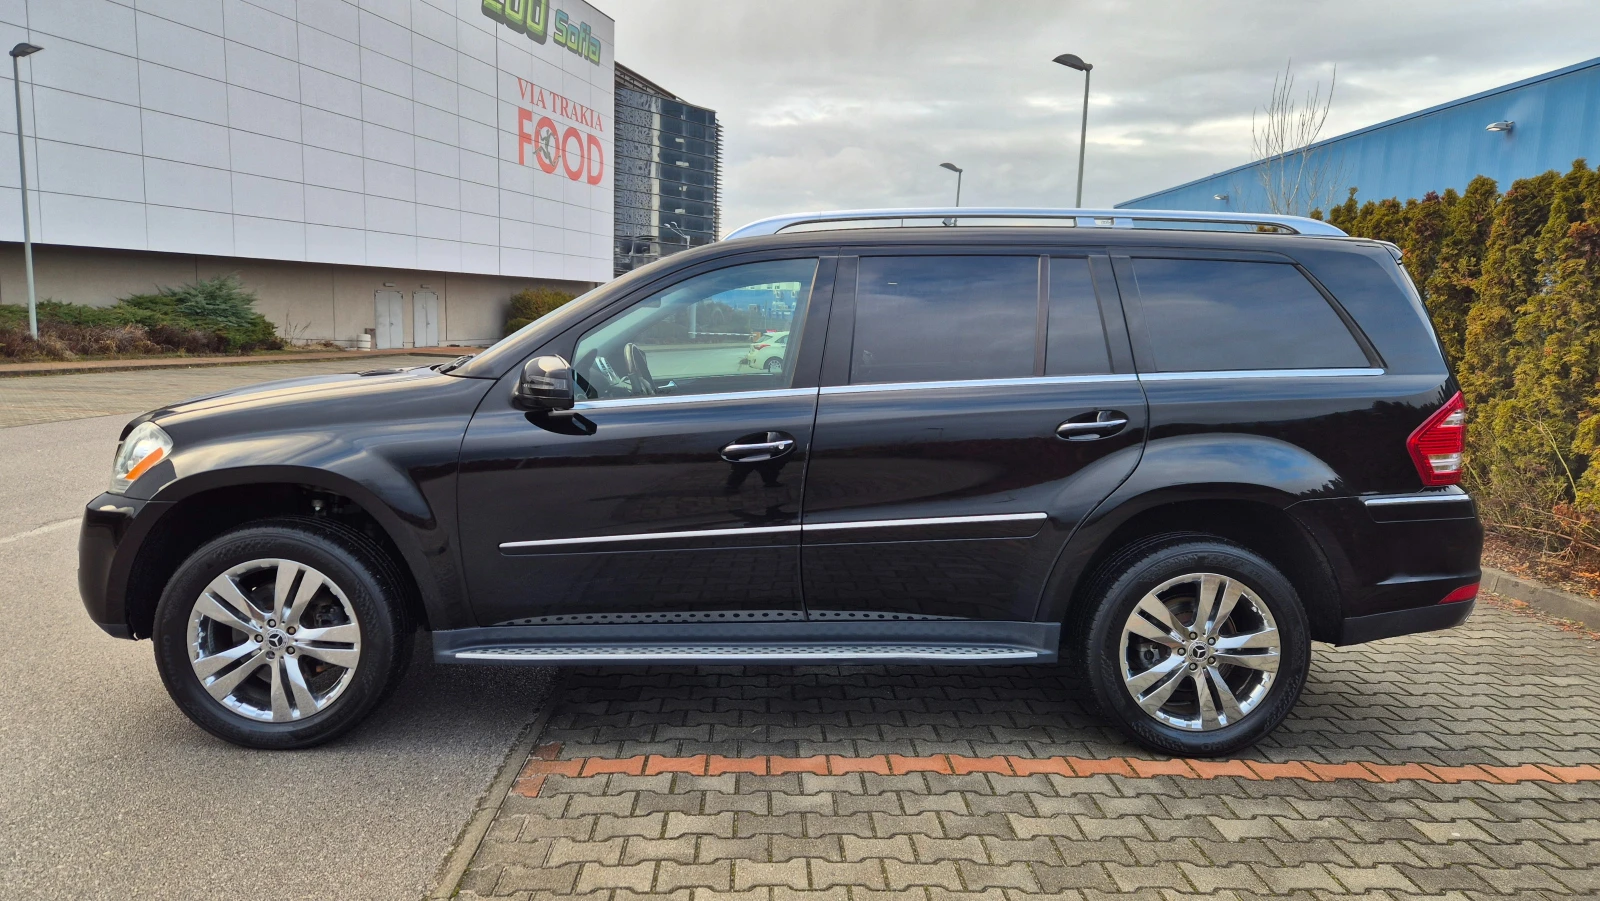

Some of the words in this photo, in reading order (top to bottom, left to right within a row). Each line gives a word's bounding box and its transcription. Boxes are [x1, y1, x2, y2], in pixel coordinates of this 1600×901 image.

[554, 9, 601, 66] Sofia
[517, 77, 547, 110] VIA
[550, 91, 604, 132] TRAKIA
[517, 106, 604, 186] FOOD
